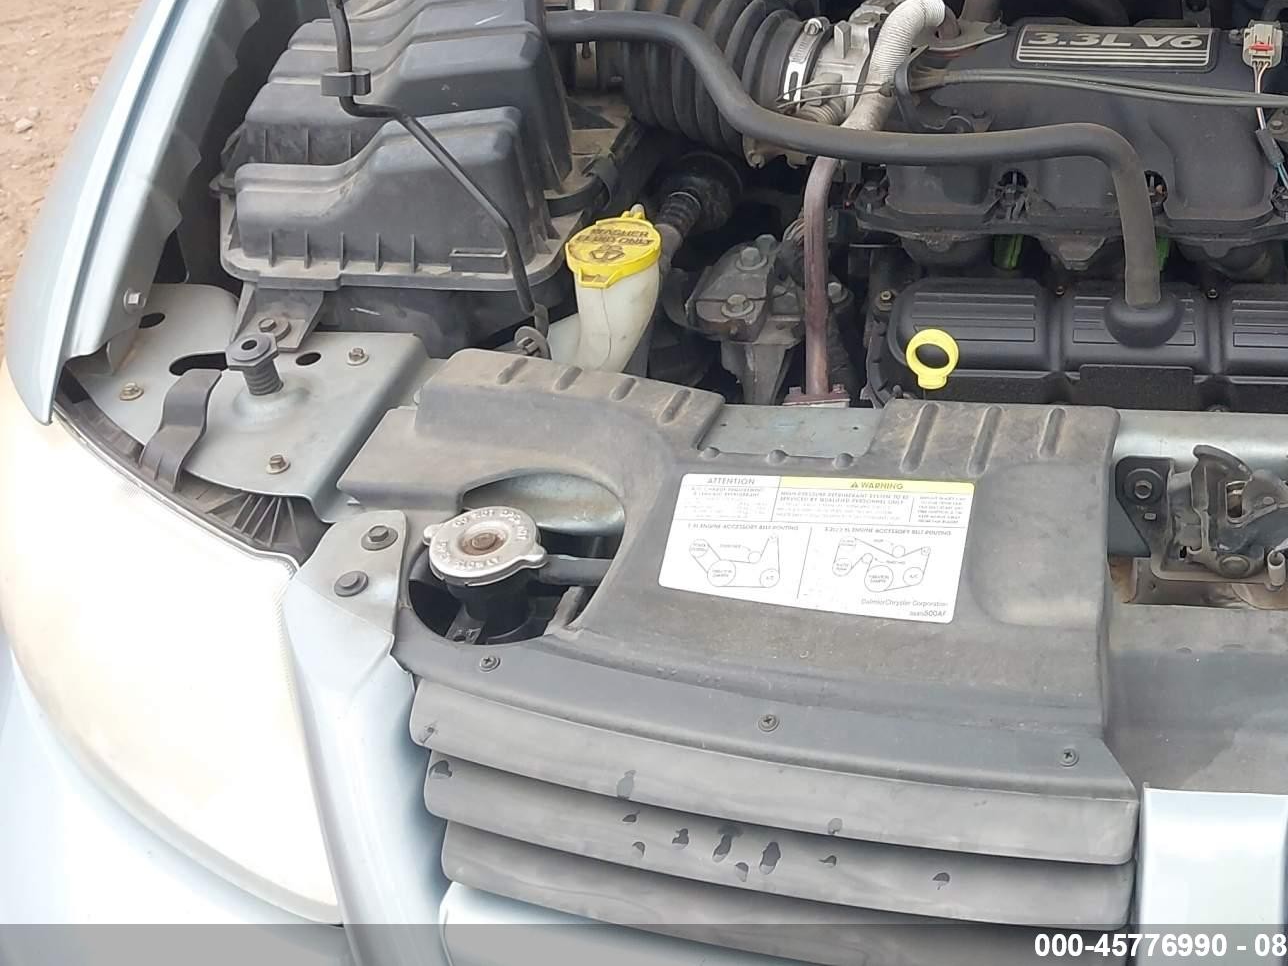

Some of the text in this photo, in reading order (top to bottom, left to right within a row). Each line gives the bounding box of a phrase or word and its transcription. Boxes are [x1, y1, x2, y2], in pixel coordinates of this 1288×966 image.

[1028, 32, 1203, 48] 3.3L V6
[591, 228, 648, 237] WASHER
[619, 237, 654, 245] ONLY
[707, 477, 756, 485] ATTENTION
[860, 481, 904, 490] WARNING
[912, 599, 949, 608] Corporation
